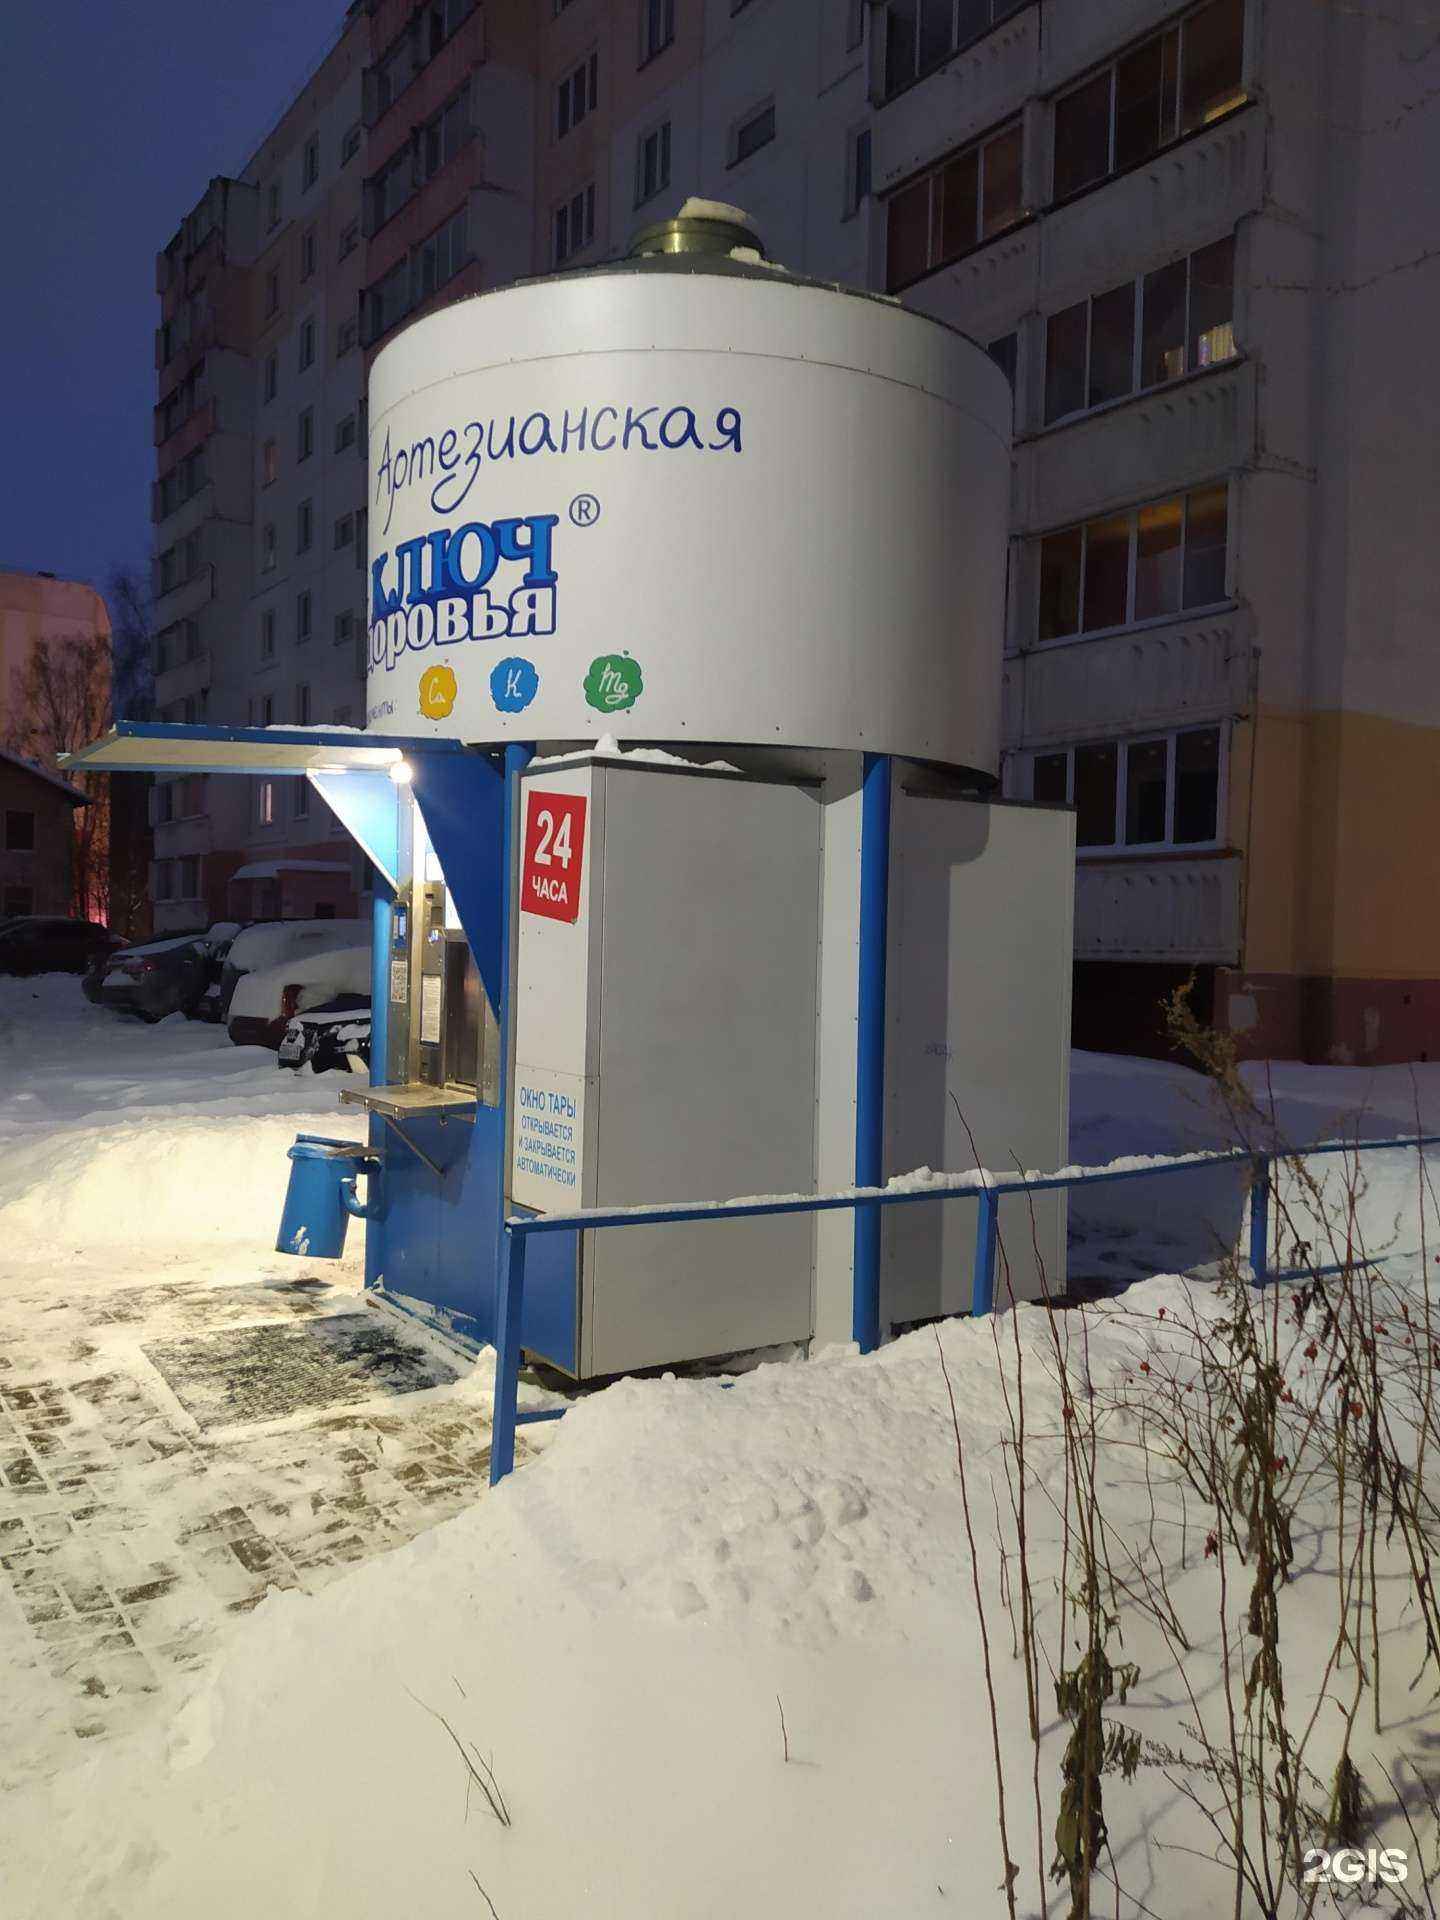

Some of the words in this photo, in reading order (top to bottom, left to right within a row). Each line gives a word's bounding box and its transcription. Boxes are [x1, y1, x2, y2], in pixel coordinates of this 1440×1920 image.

[376, 405, 743, 535] Артезианская
[598, 663, 630, 705] Mg
[534, 809, 573, 870] 24
[532, 875, 569, 905] ЧАСА
[520, 1086, 546, 1111] ОКНО
[548, 1092, 577, 1119] ТАРЫ
[521, 1115, 573, 1143] ОТКРЫВАЕТСЯ
[524, 1136, 576, 1165] ЗАКРЫВАЕТСЯ
[517, 1155, 576, 1189] АВТОМАТИЧЕСКИ
